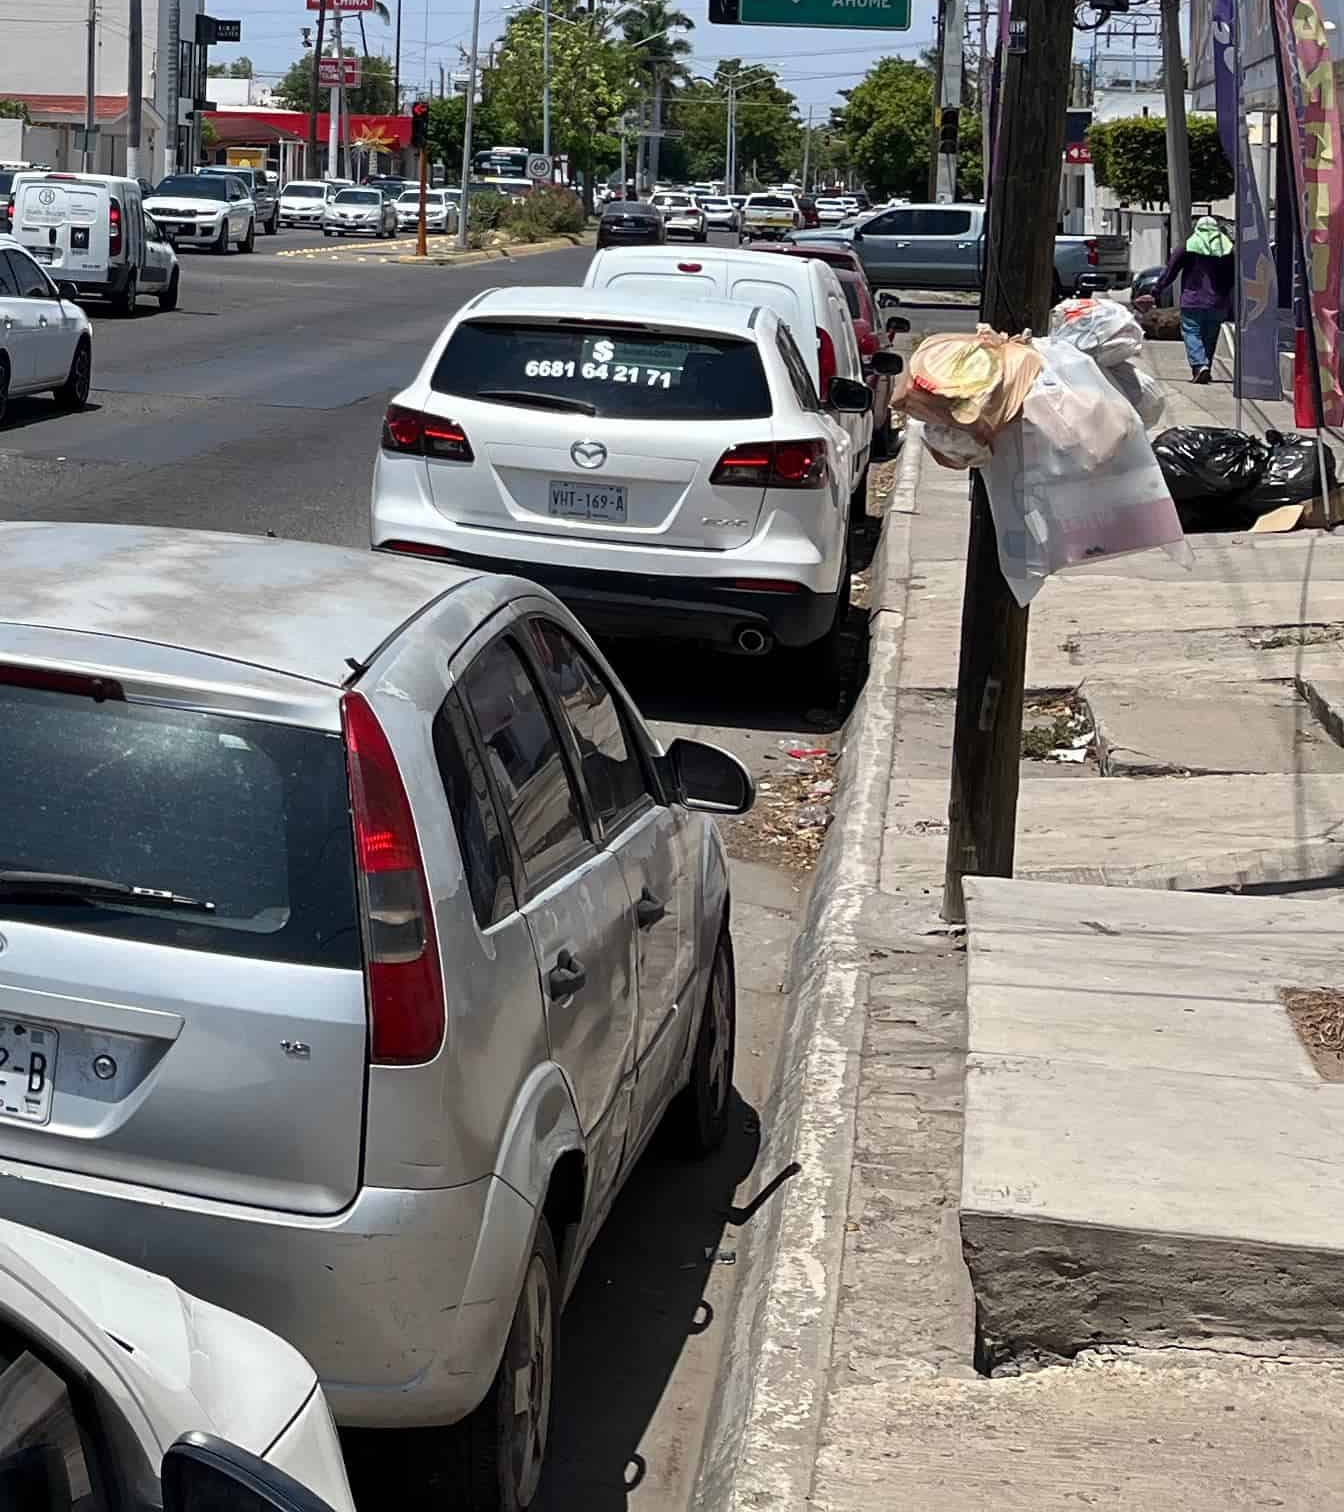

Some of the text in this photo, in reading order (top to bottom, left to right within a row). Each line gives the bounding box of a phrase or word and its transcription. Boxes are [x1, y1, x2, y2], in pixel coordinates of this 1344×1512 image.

[525, 360, 672, 390] 6681 64 21 71
[552, 489, 625, 512] VHT-169-A
